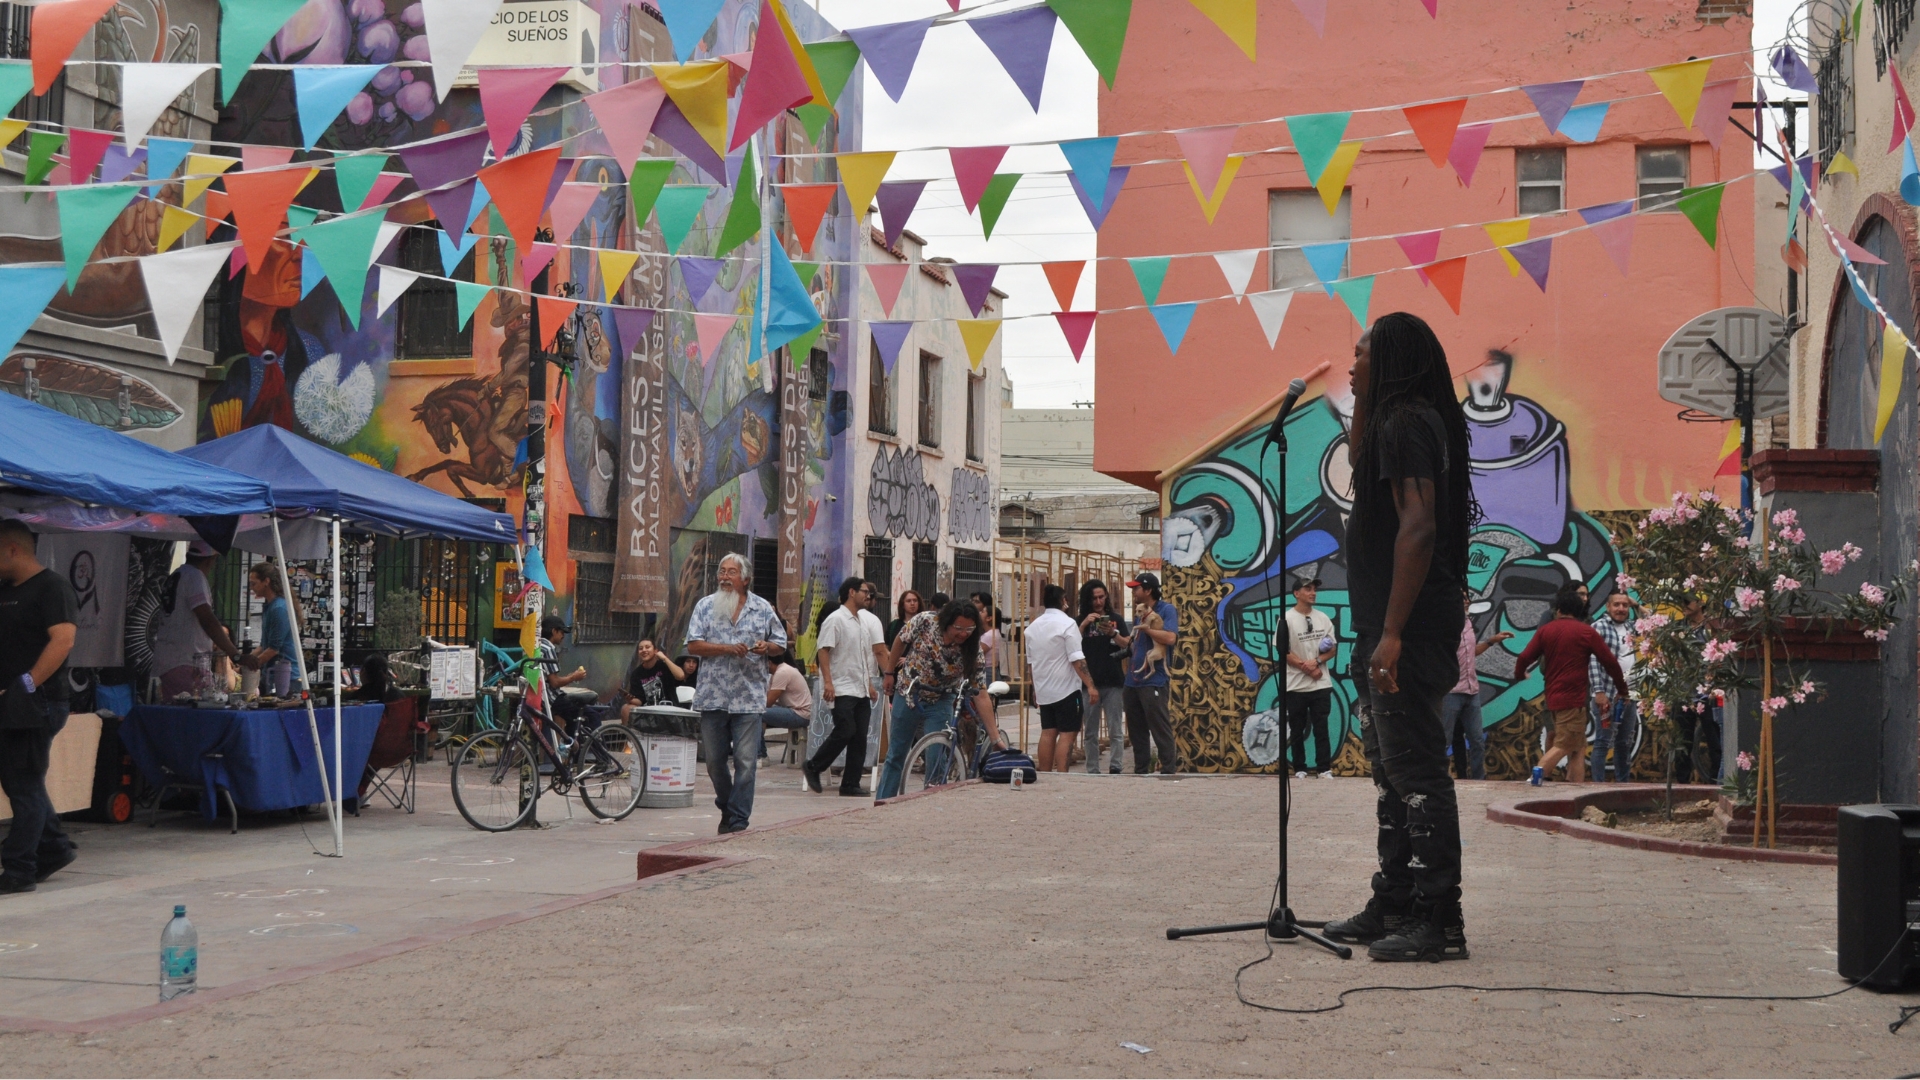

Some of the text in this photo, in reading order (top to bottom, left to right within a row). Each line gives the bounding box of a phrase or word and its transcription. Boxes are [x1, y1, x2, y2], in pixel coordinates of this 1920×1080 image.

[507, 26, 568, 42] SUEÑOS
[518, 11, 537, 24] DE
[540, 9, 569, 23] LOS
[627, 376, 649, 557] RAÍCES
[783, 423, 798, 574] RAÍCES
